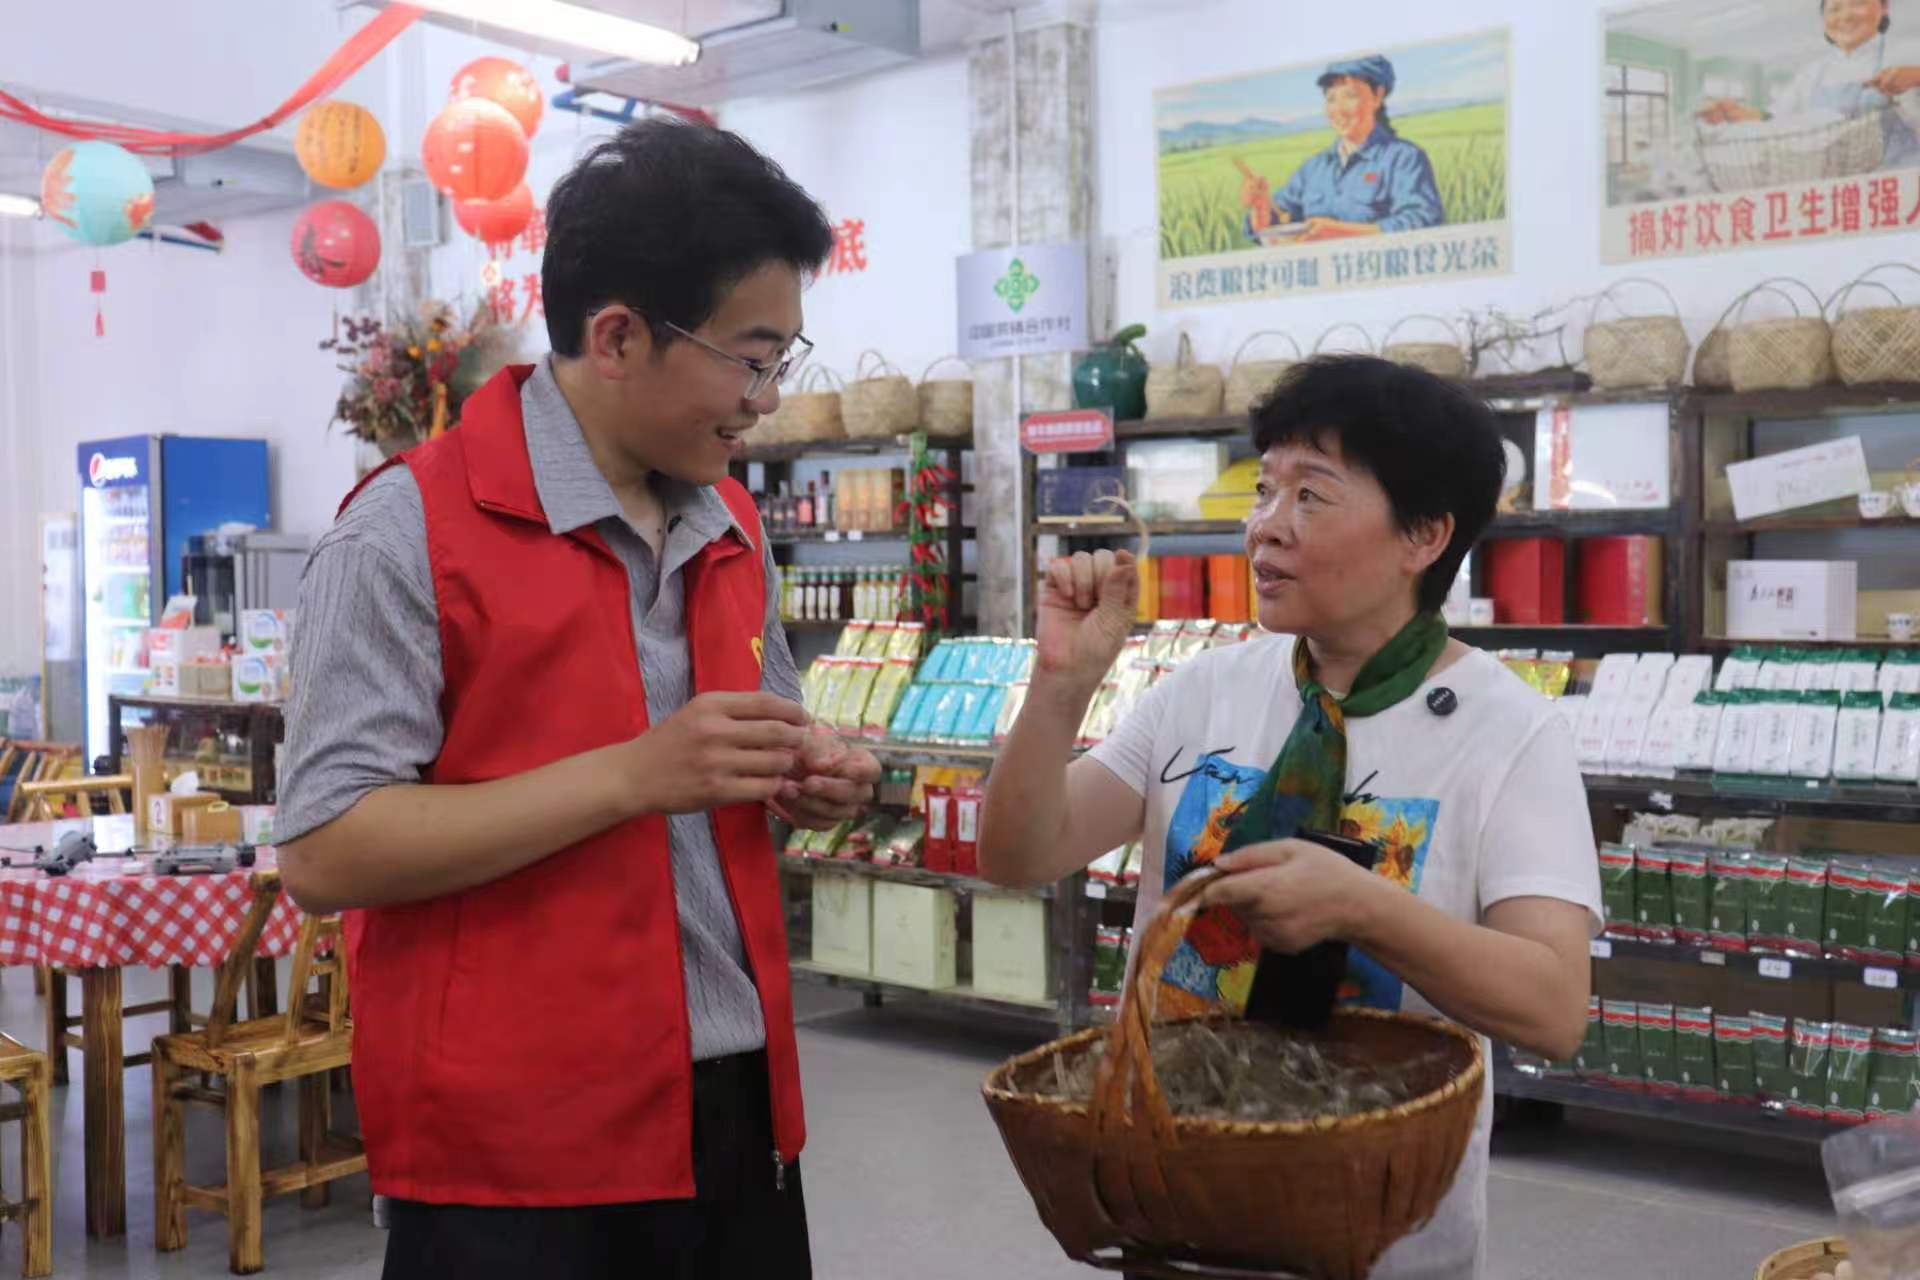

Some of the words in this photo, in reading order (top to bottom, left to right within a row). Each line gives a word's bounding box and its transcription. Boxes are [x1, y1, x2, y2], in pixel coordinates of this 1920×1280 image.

[1168, 257, 1320, 300] 浪费粮食可耻
[1331, 236, 1499, 285] 节约粮食光荣
